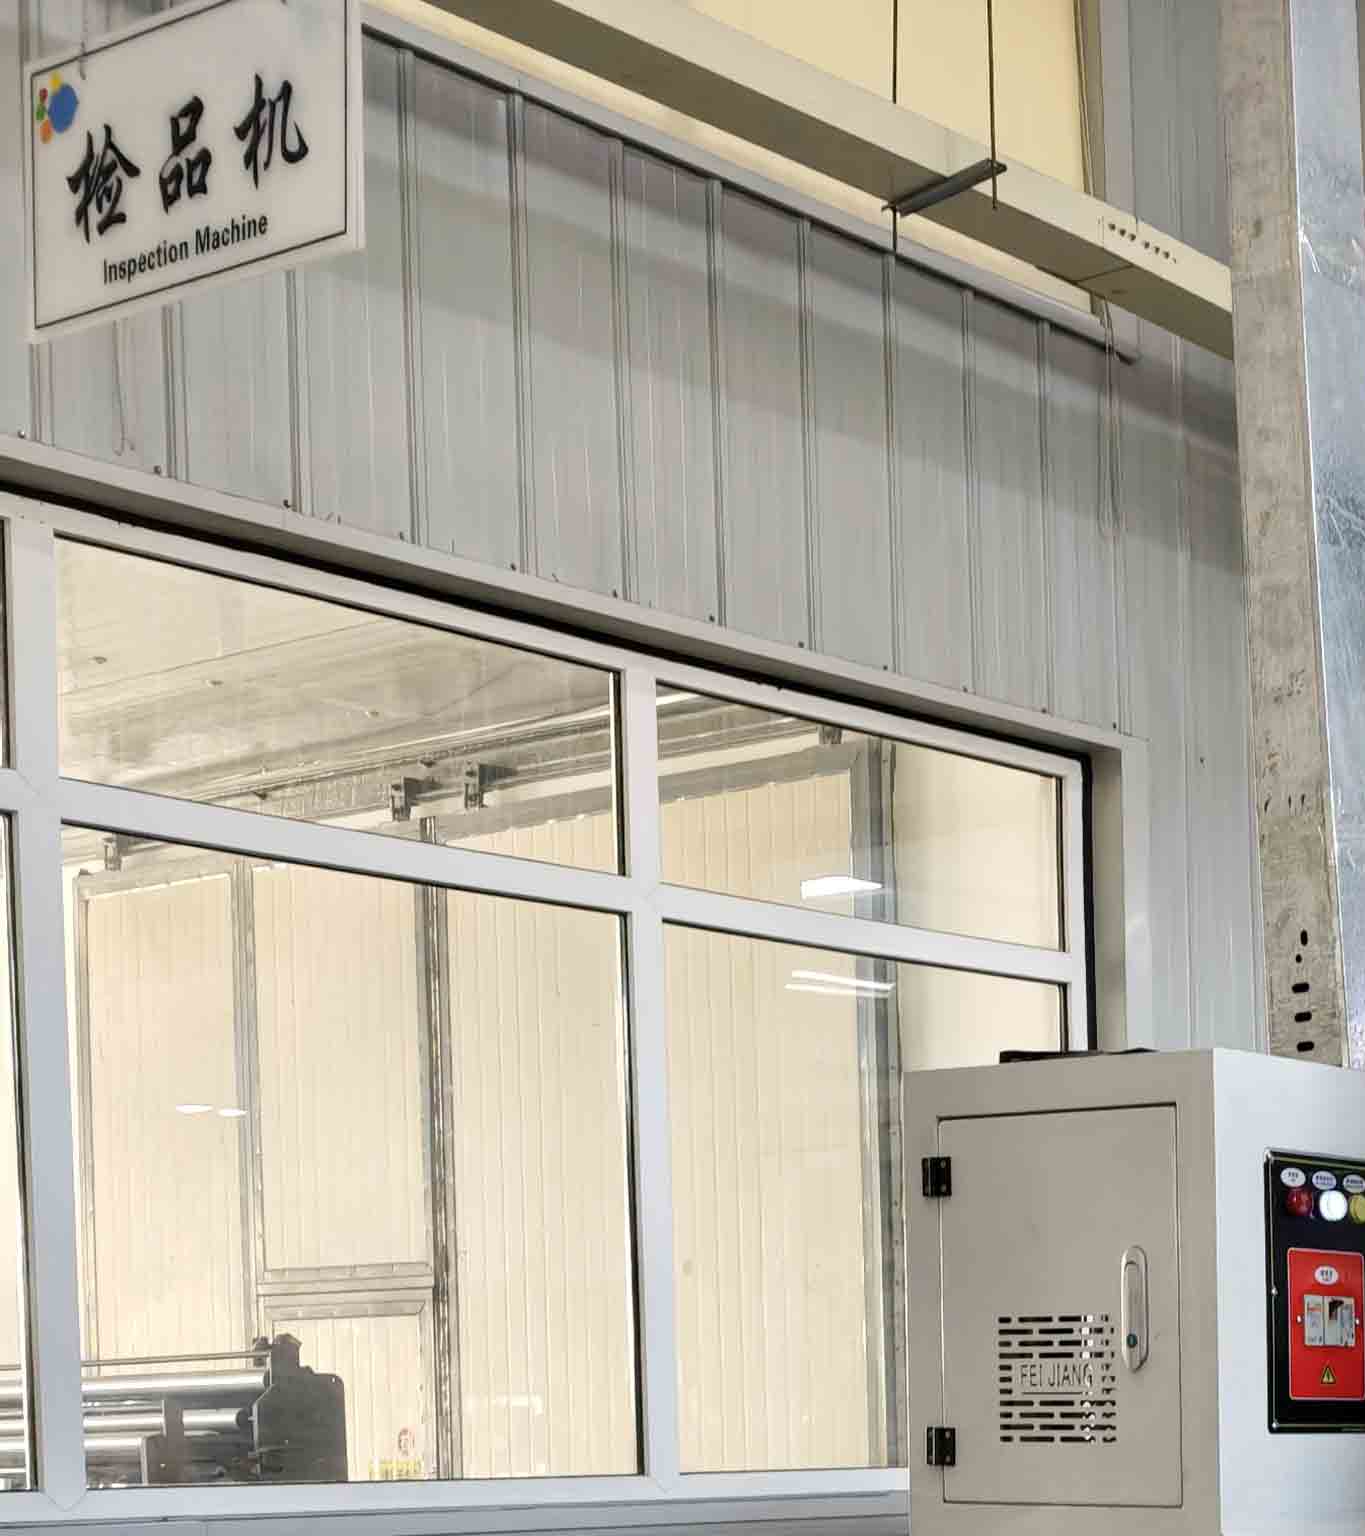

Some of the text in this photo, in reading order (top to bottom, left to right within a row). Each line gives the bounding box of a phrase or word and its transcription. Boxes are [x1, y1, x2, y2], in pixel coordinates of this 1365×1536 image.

[66, 73, 309, 243] 检品机
[103, 214, 269, 285] Inspection Machine
[1019, 1363, 1093, 1388] FEI JIANG
